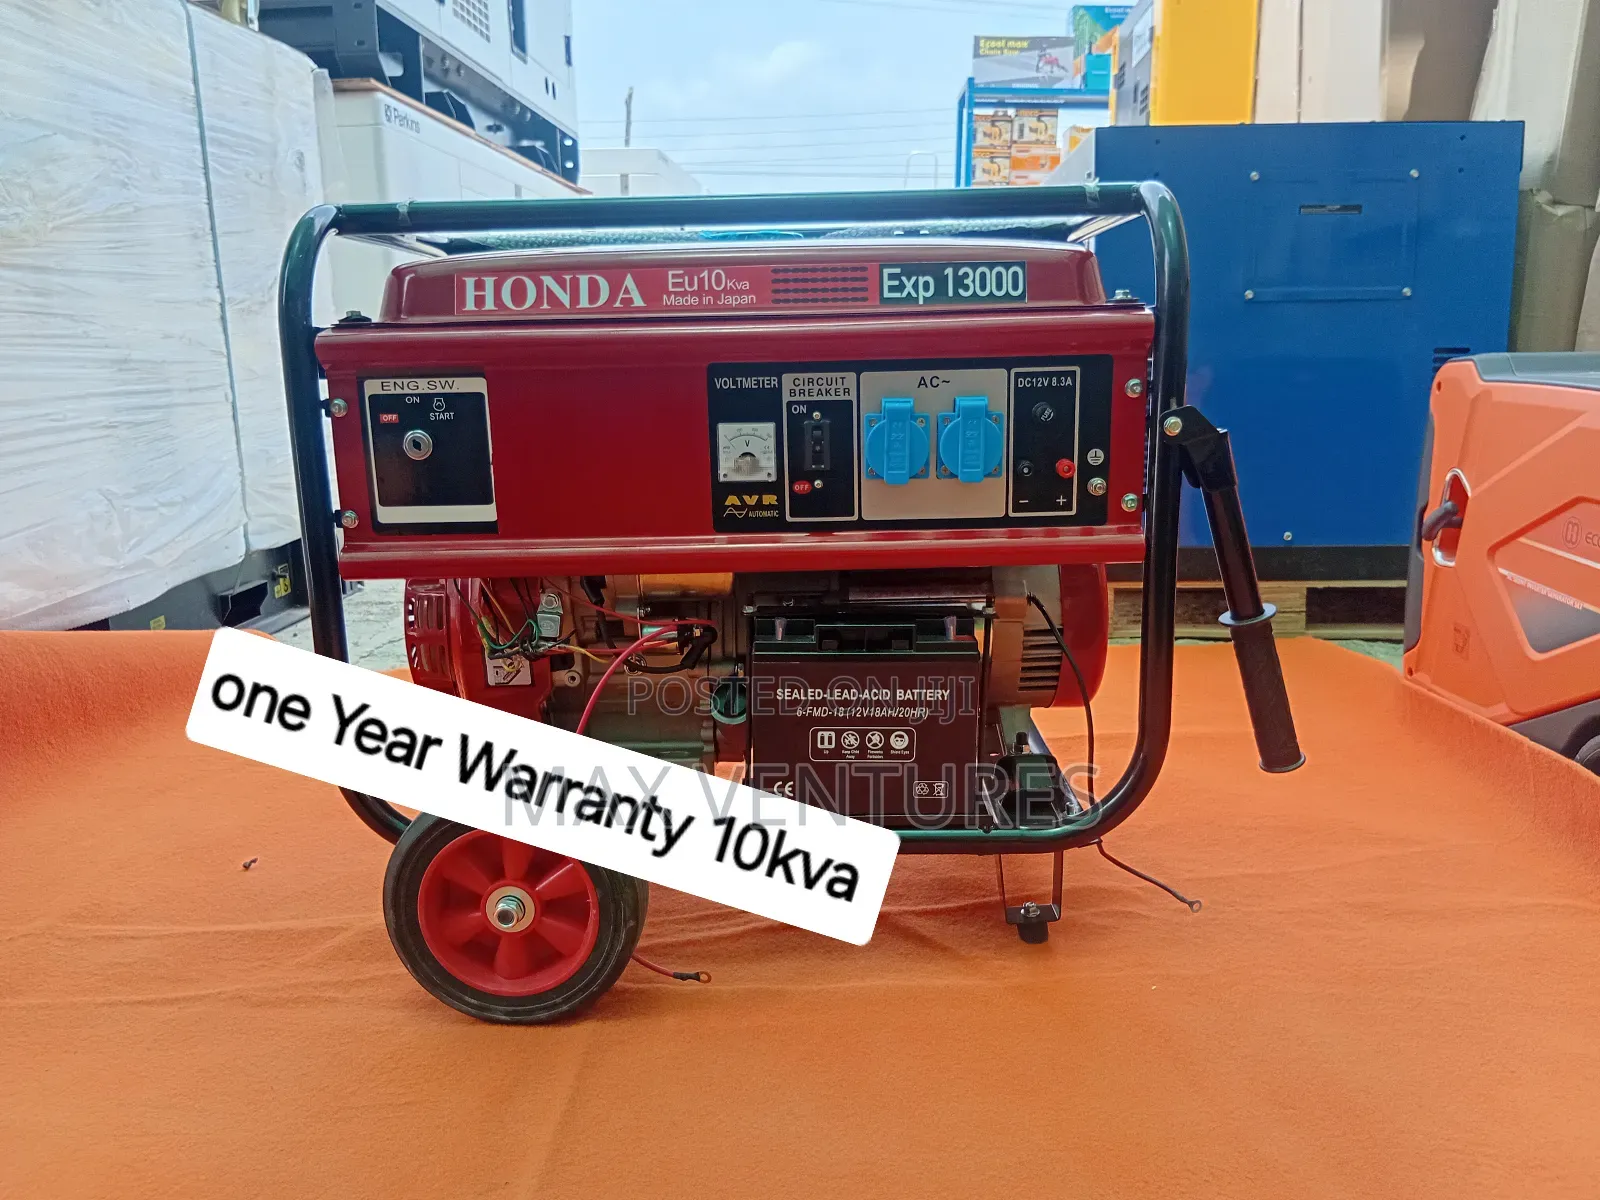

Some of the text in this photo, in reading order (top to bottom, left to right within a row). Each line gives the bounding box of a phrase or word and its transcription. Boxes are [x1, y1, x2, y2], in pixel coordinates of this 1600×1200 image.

[667, 269, 726, 291] Eu10
[882, 266, 1024, 304] Exp 13000
[462, 273, 647, 311] HONDA
[662, 293, 756, 307] Made in Japan
[380, 380, 460, 392] ENG.SW.
[714, 376, 778, 389] VOLTMETER
[792, 376, 847, 387] CIRCUIT
[1017, 376, 1073, 388] DC12V 8.3A
[789, 387, 851, 398] BREAKER
[405, 396, 420, 404] ON
[791, 404, 807, 415] ON
[382, 414, 397, 422] OFF
[429, 412, 455, 421] START
[744, 439, 750, 448] V
[724, 494, 779, 506] AVR
[748, 510, 780, 518] AUTOMATIC
[896, 689, 950, 700] BATTERY
